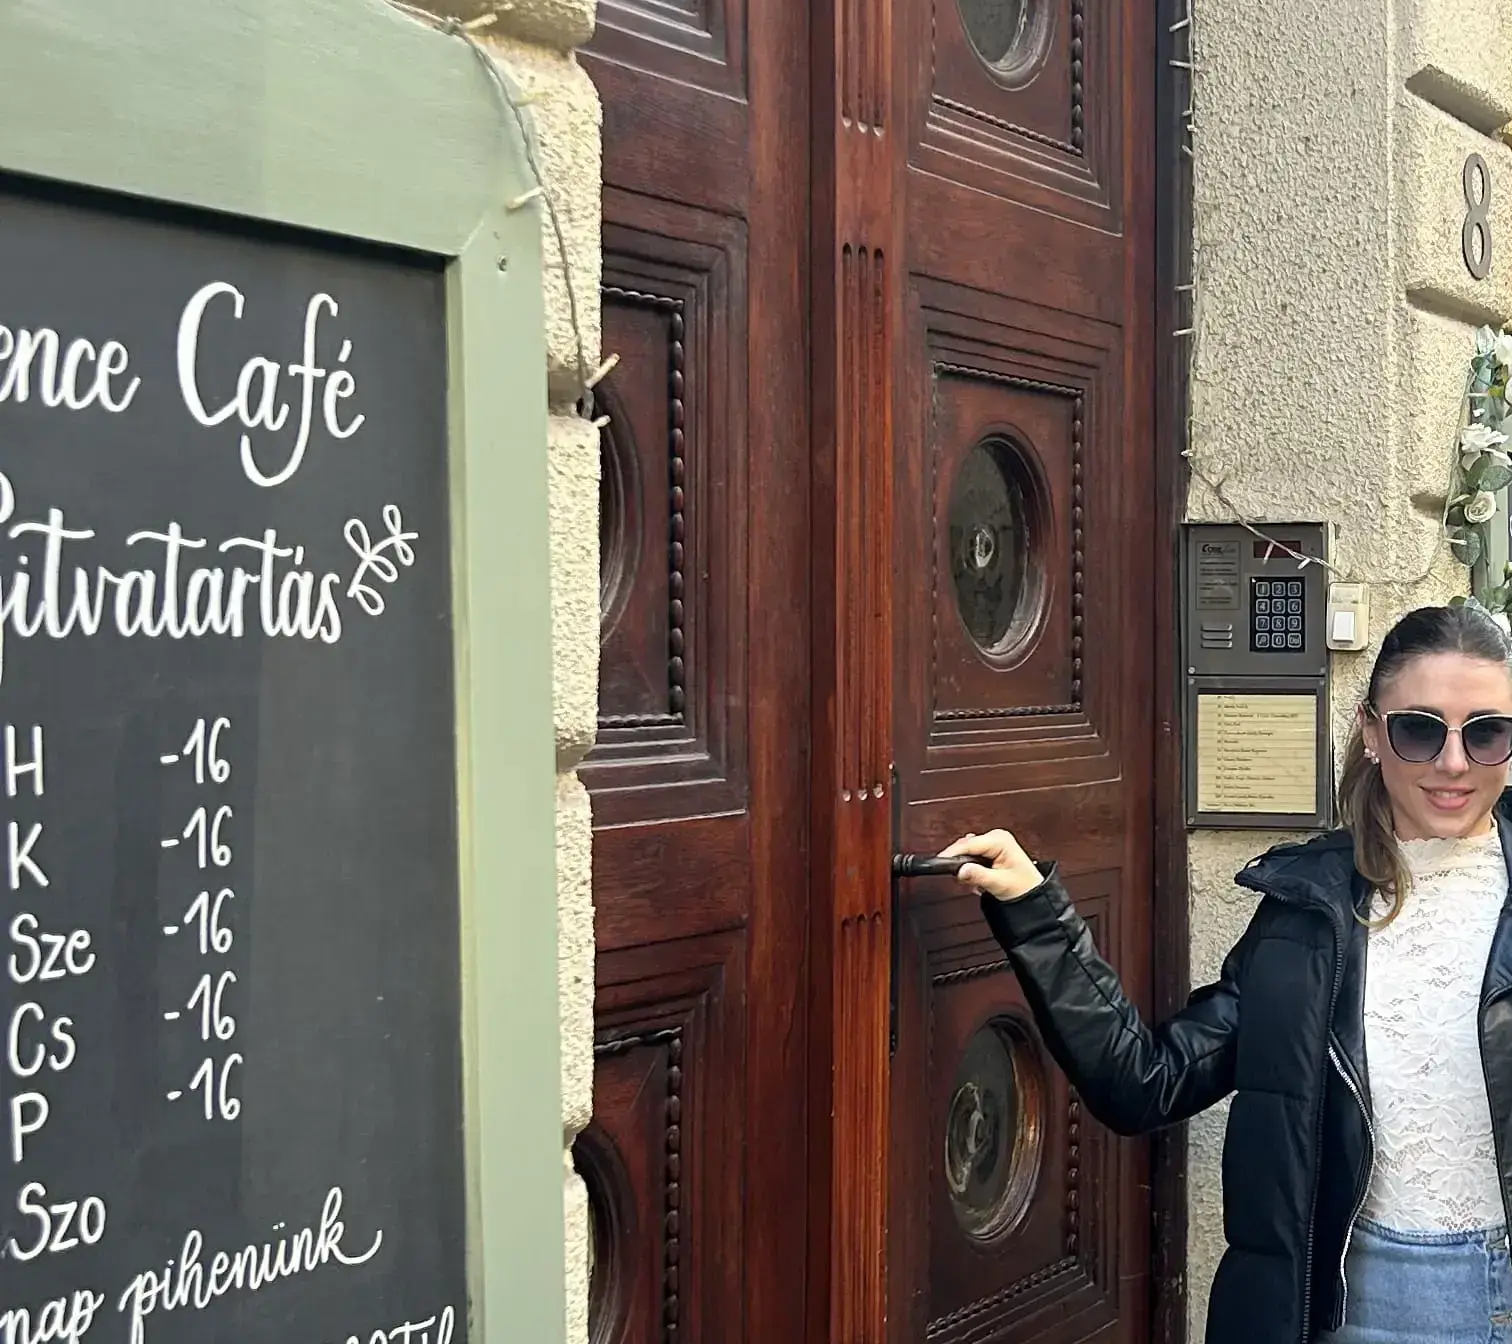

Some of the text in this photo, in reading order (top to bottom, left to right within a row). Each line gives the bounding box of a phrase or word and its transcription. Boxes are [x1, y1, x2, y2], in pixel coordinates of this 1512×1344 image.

[1463, 153, 1492, 281] 8
[176, 281, 365, 488] Café
[0, 496, 342, 684] itvatartás
[5, 717, 231, 796] H -16
[8, 805, 233, 889] K -16
[8, 888, 235, 983] Sze -16
[8, 971, 237, 1077] Cs -16
[10, 1053, 243, 1162] P -16
[9, 1182, 106, 1260] Szo
